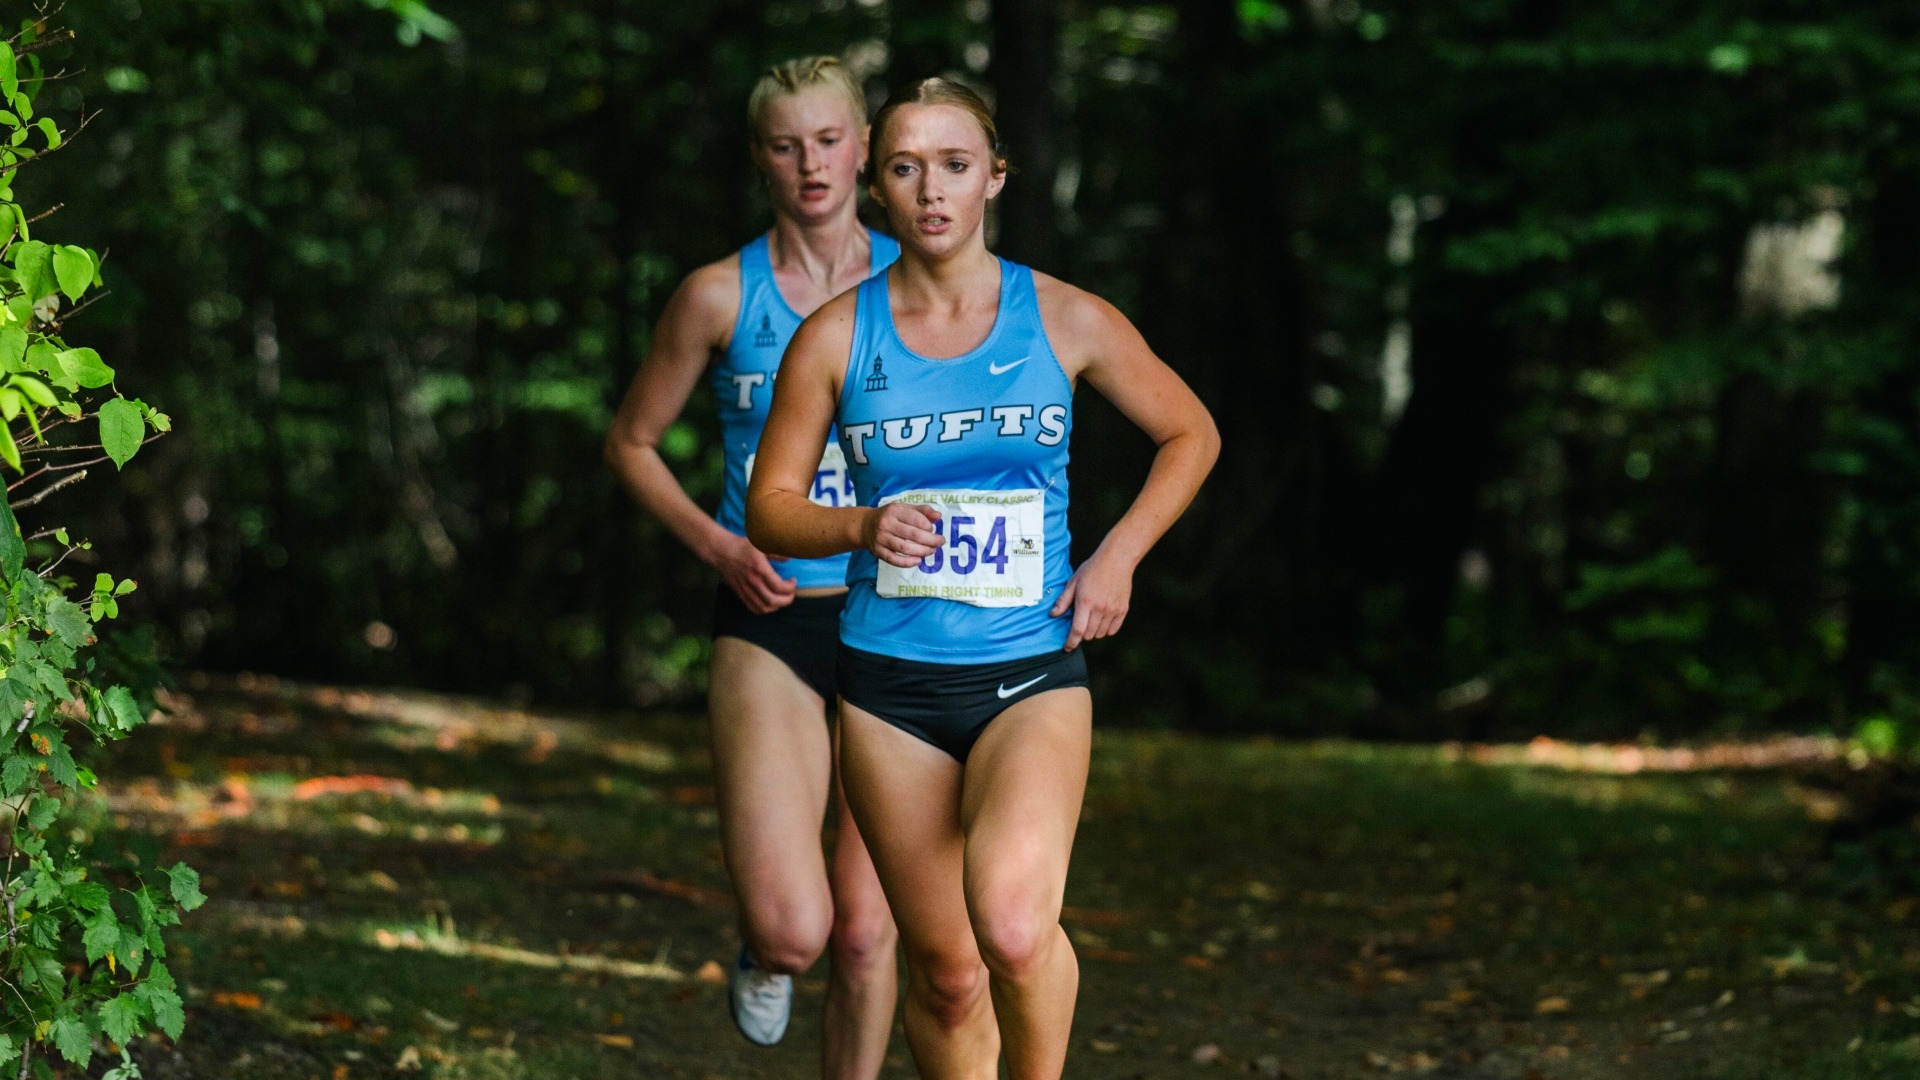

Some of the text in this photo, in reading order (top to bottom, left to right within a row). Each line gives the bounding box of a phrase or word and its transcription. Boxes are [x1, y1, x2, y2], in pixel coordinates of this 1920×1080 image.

[844, 404, 1067, 465] TUFTS
[893, 494, 1034, 505] RPLE VALLEY CLASSIC
[898, 585, 1024, 598] FINISH RIGHT TIMING
